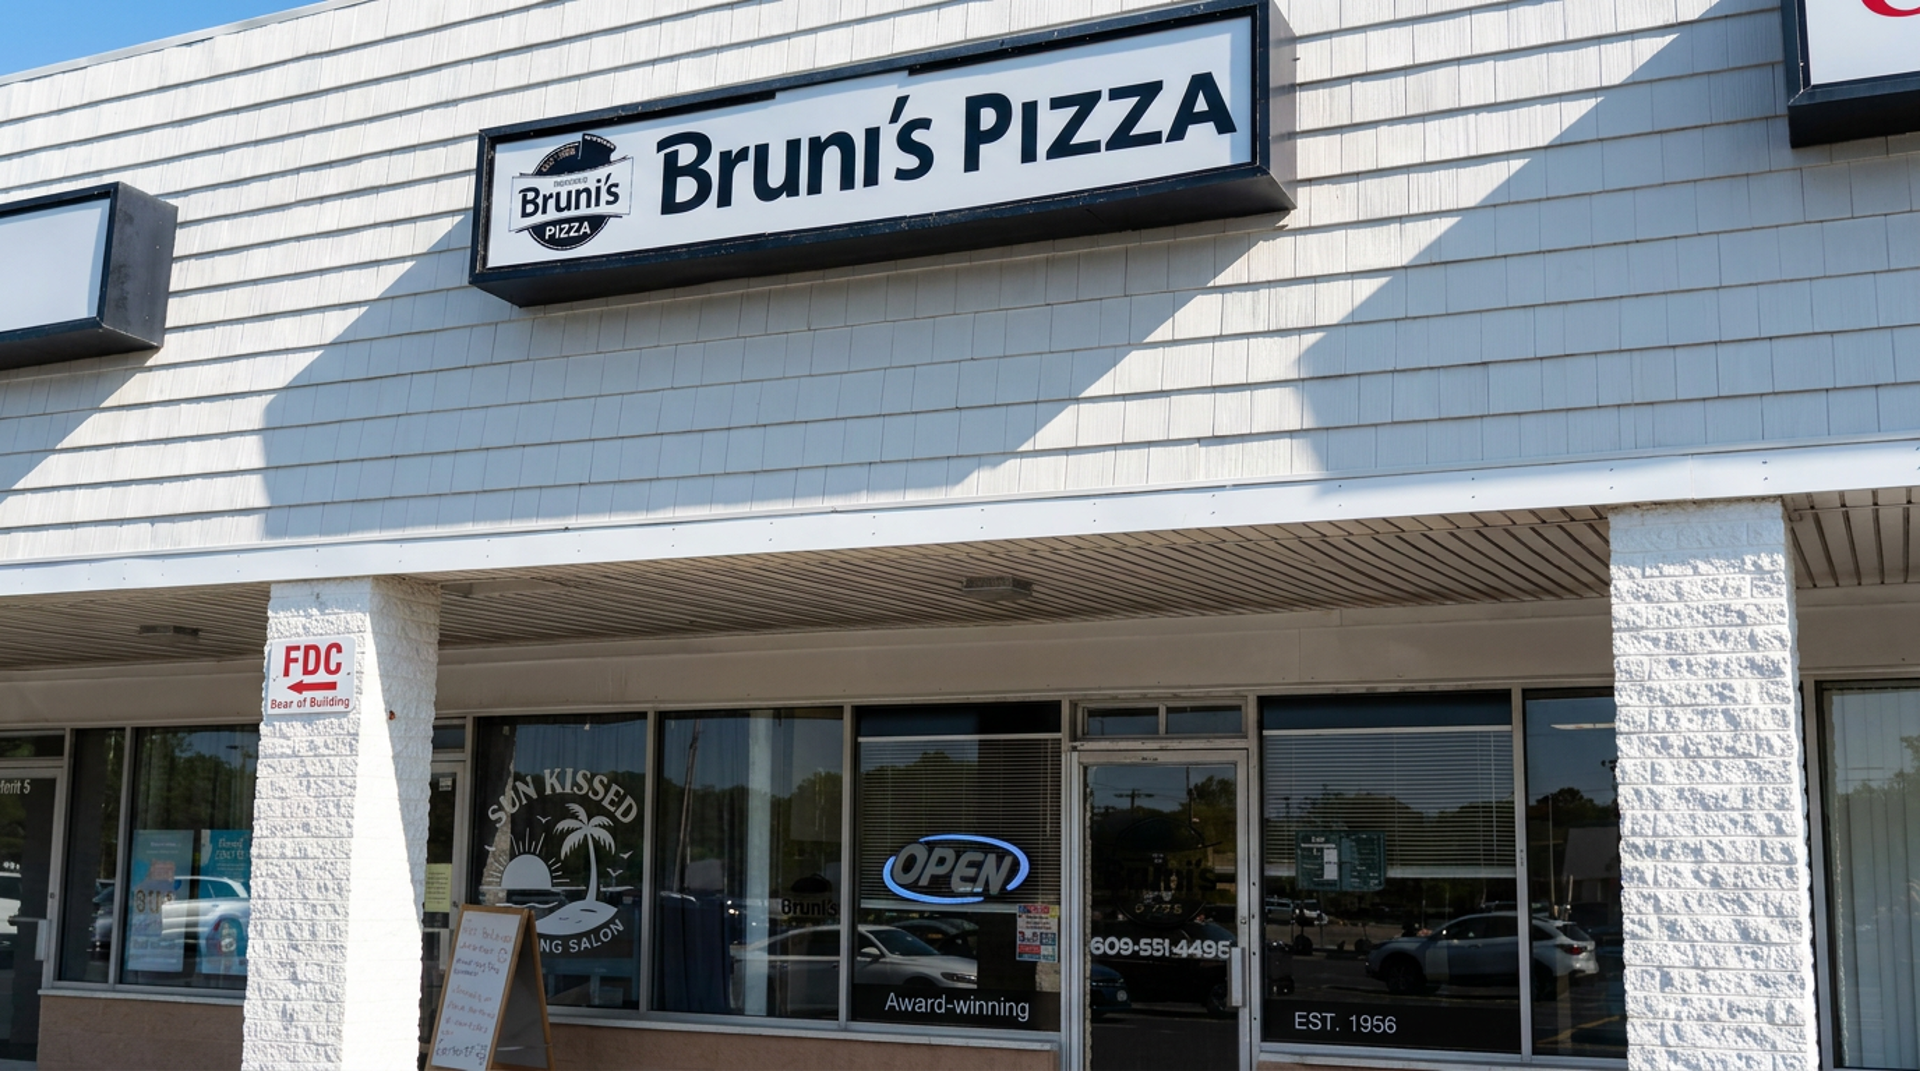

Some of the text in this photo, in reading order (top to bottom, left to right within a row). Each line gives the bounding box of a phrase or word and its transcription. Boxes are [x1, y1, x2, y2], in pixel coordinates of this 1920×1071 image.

[656, 71, 1238, 216] Bruni's PIZZA
[518, 172, 620, 219] Bruni's
[545, 221, 591, 240] PIZZA
[282, 642, 343, 678] FDC
[270, 699, 294, 709] Bear
[296, 696, 307, 708] of
[487, 767, 638, 828] SUN KISSED
[892, 842, 1014, 896] OPEN
[568, 918, 624, 953] SALON
[884, 992, 1030, 1022] Award-winning
[1294, 1011, 1397, 1034] EST. 1956
